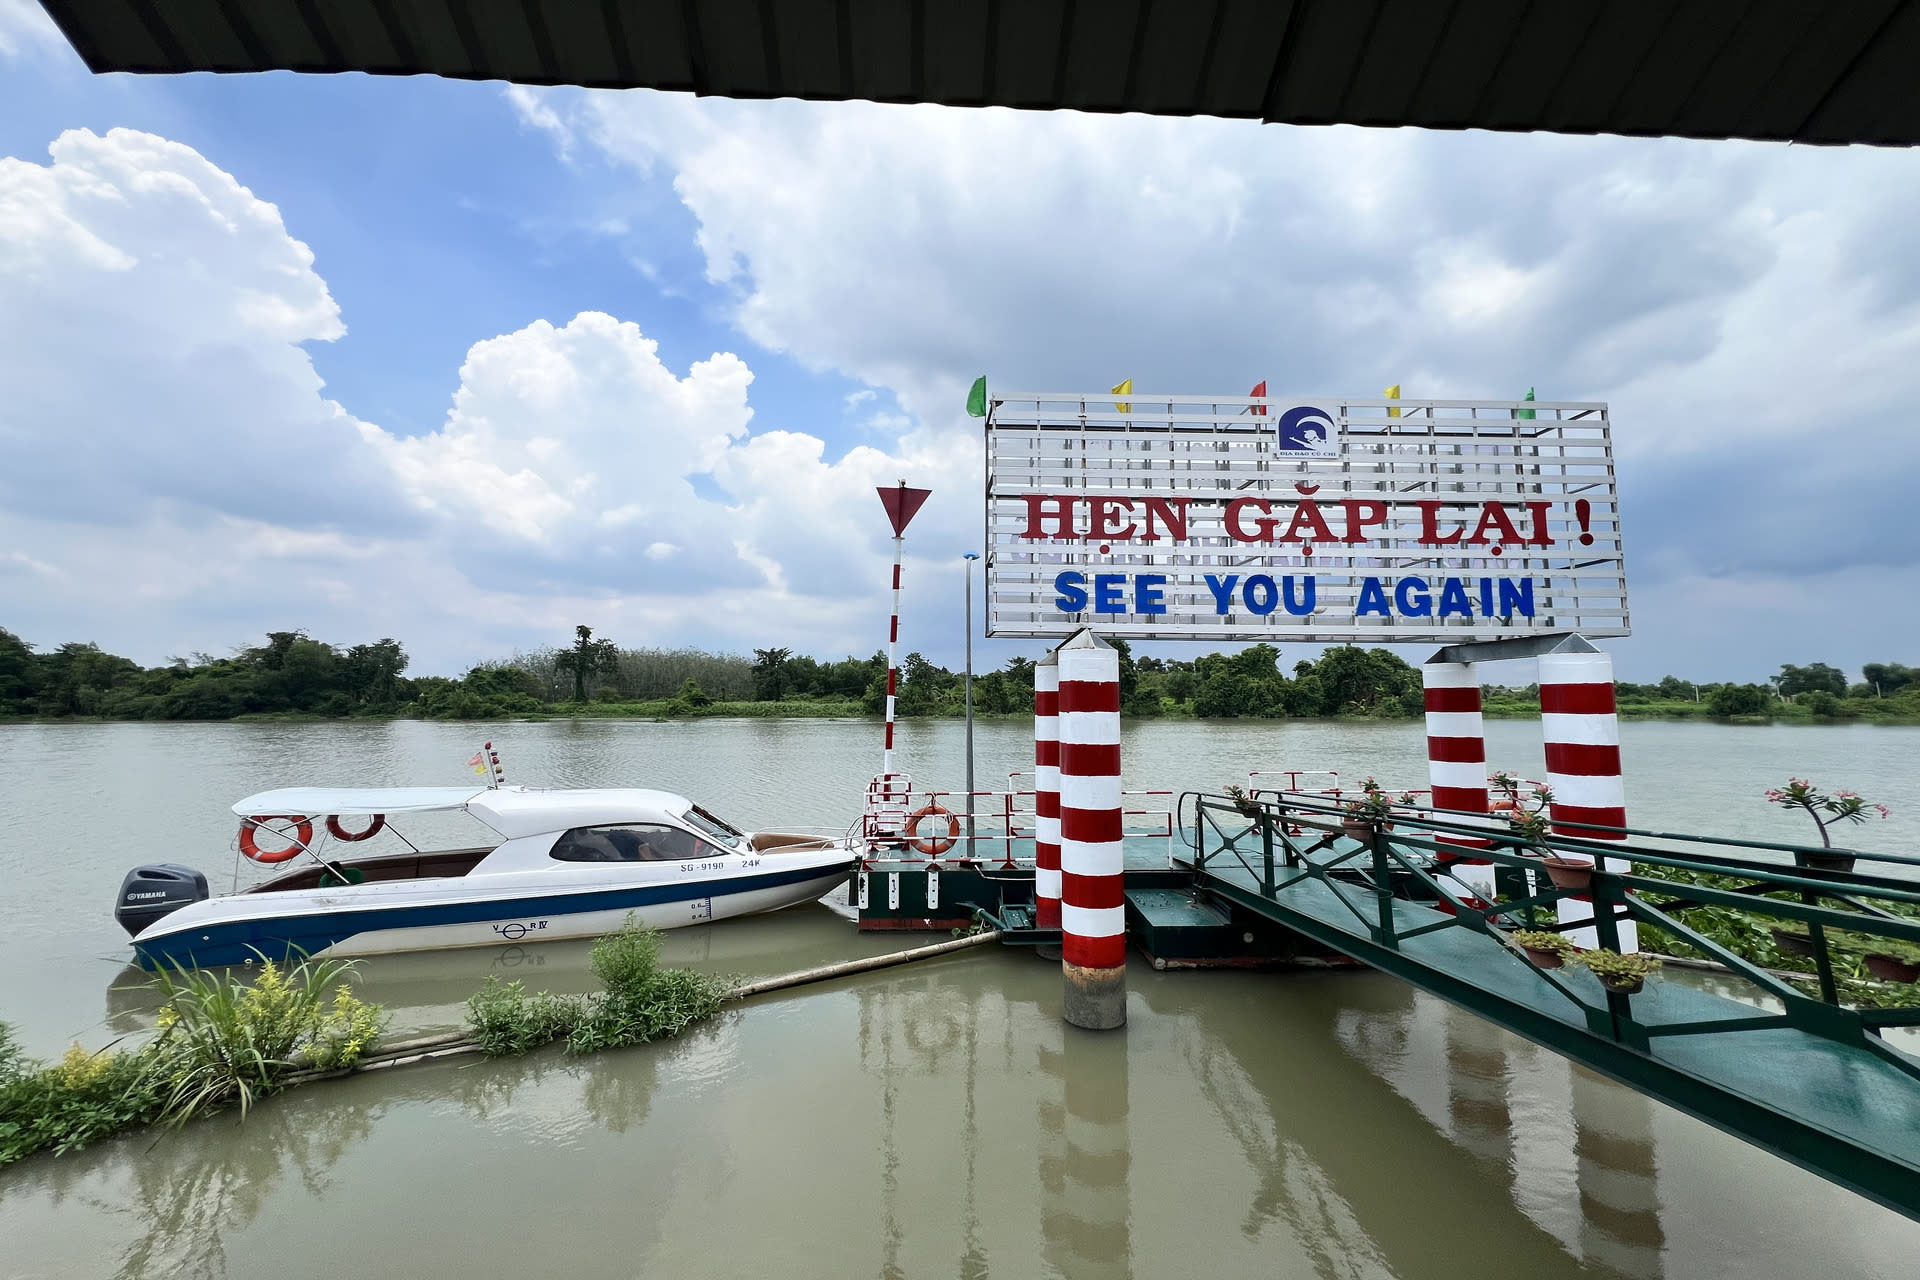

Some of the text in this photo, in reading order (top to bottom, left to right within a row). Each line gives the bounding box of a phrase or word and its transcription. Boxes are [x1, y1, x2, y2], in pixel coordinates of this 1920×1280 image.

[1020, 494, 1193, 554] HẸN
[1224, 484, 1388, 556] GẶP
[1056, 572, 1534, 617] SEE YOU AGAIN
[742, 859, 760, 868] 24K
[136, 891, 166, 899] YAMAHA
